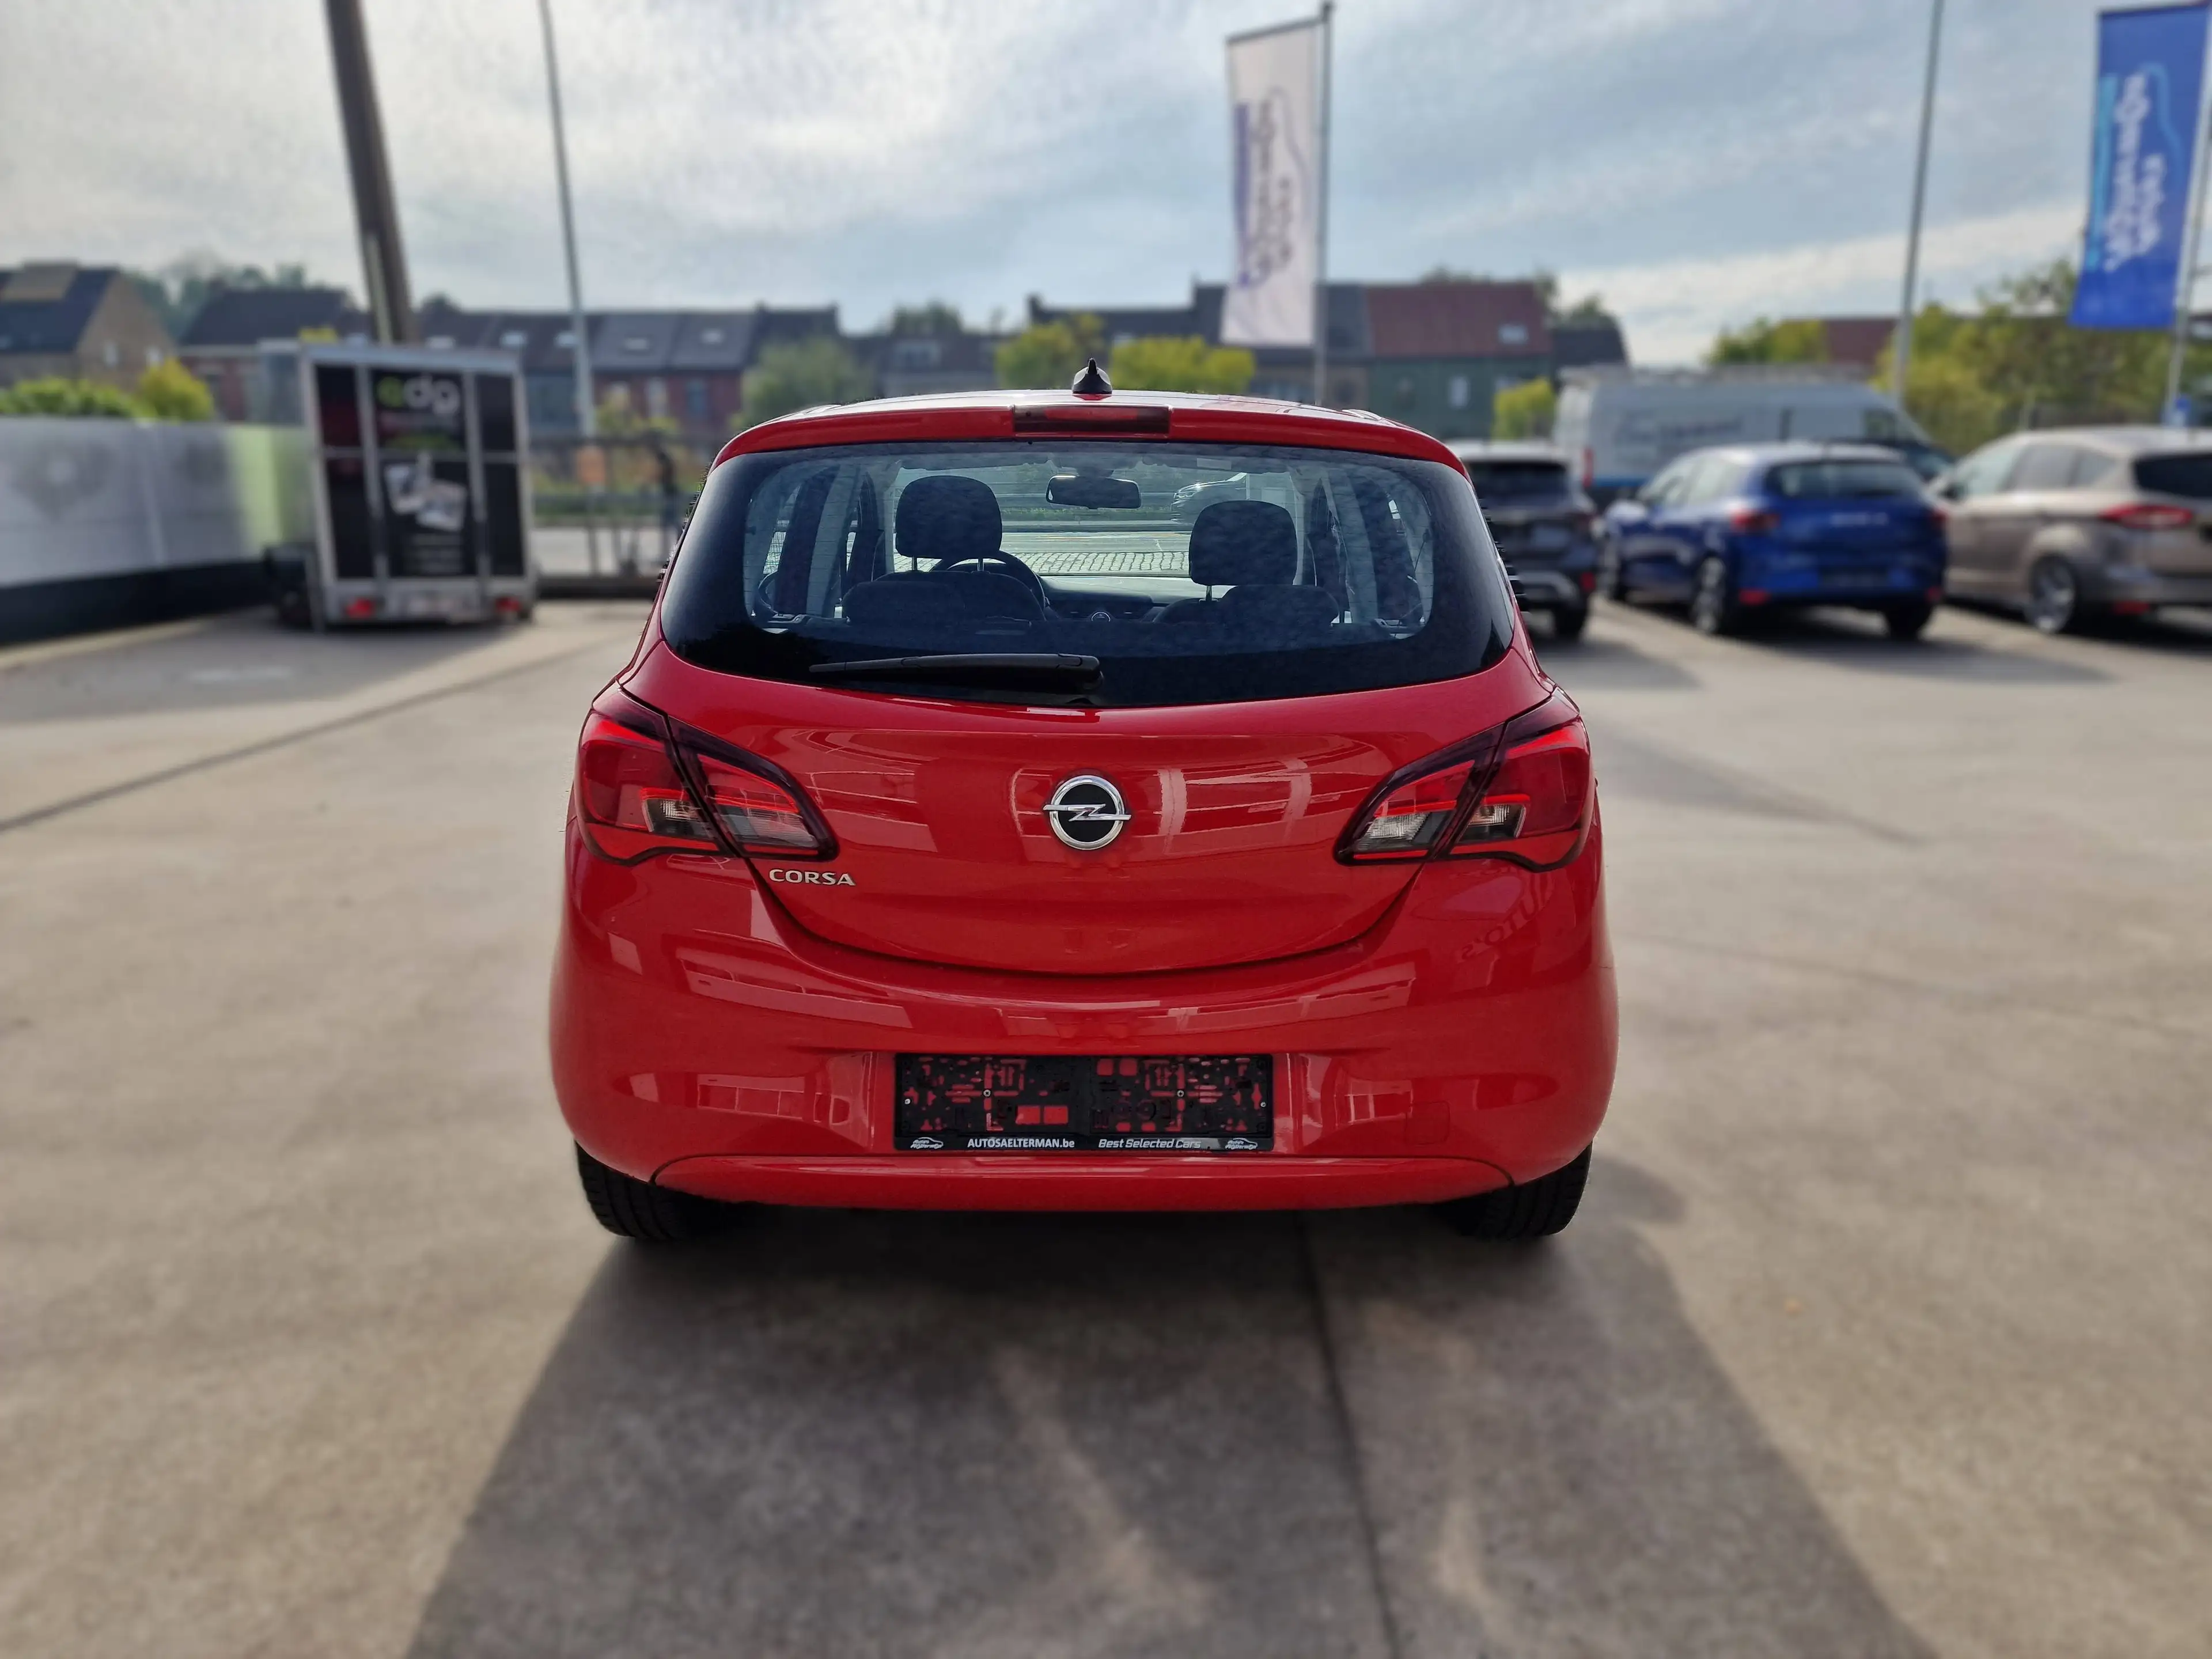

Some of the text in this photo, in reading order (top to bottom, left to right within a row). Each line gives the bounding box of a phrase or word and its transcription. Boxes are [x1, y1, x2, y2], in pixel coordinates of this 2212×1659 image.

[769, 869, 856, 886] CORSA
[967, 1138, 1075, 1147] AUTOSAELTERMAN.be
[1098, 1138, 1201, 1148] Best Selected Cars
